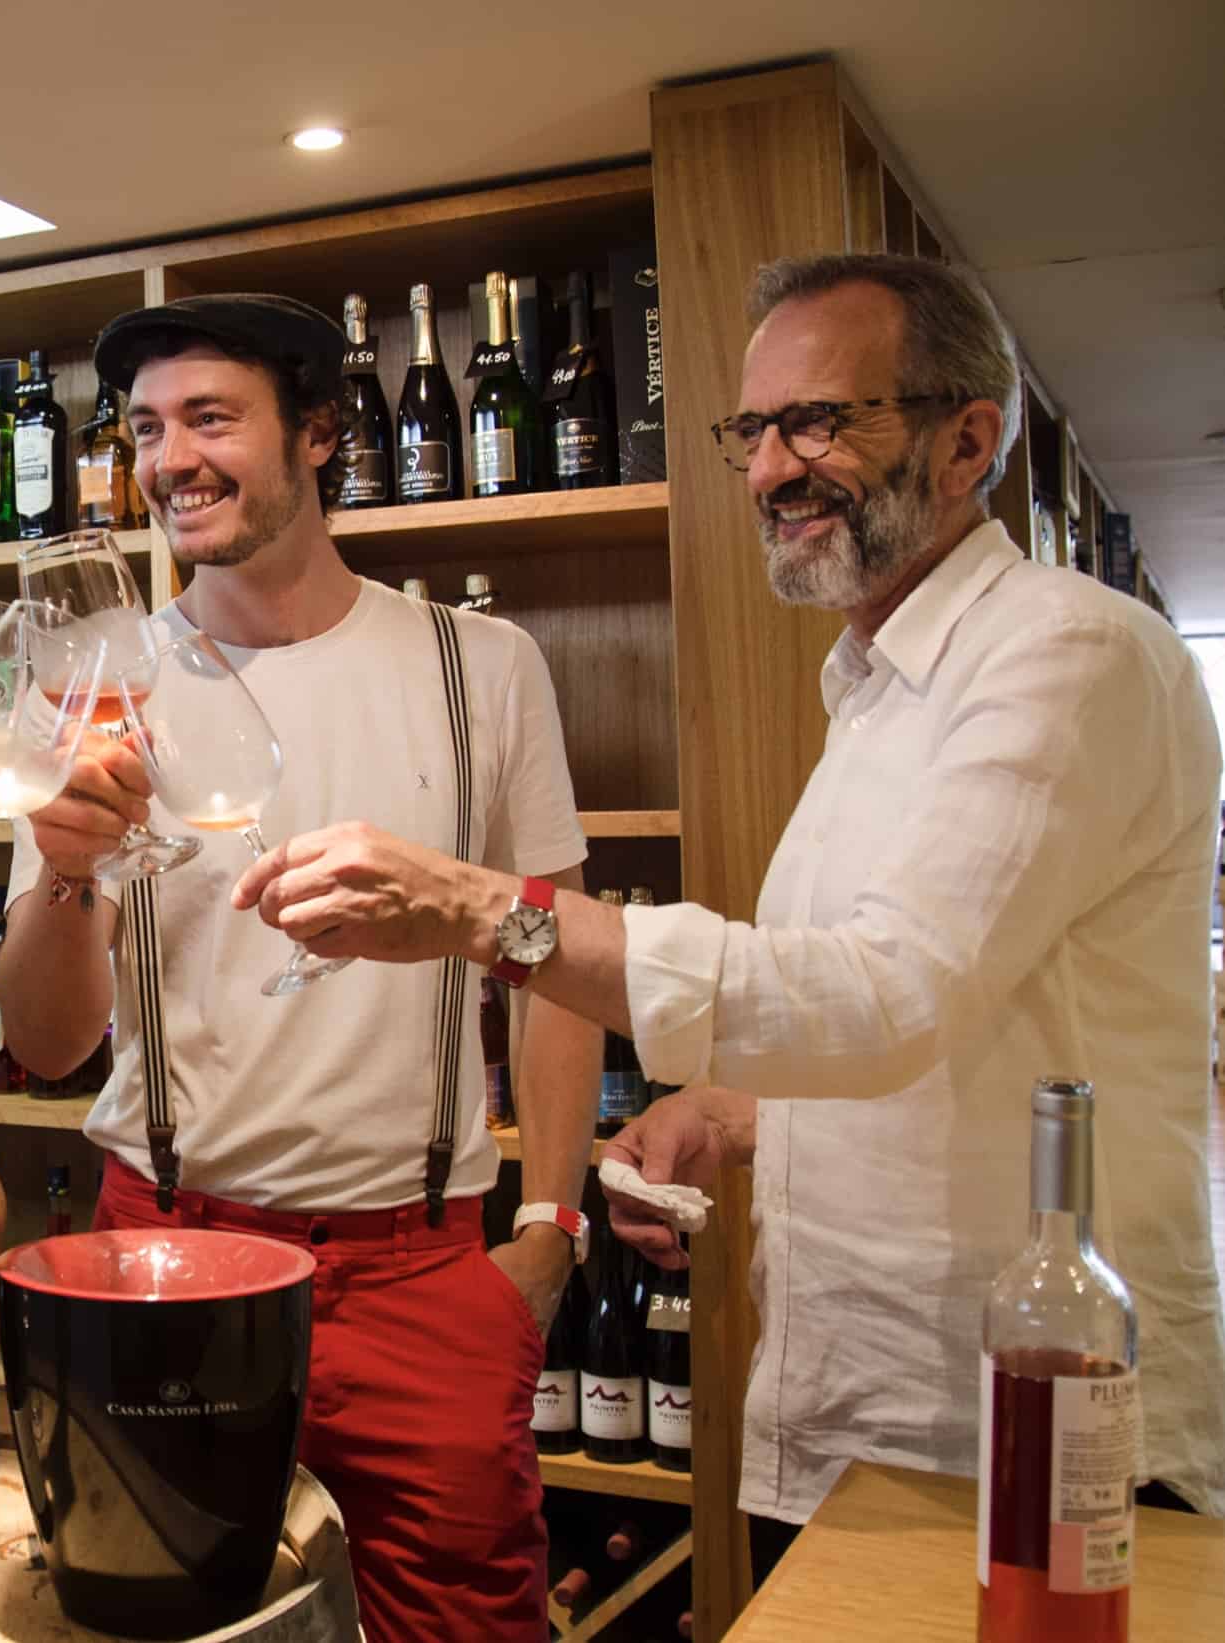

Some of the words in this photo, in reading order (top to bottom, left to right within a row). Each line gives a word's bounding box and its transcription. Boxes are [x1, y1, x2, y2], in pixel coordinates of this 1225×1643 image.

[106, 1402, 144, 1417] CASA
[146, 1404, 201, 1417] SANTOS
[203, 1401, 239, 1415] LIMA
